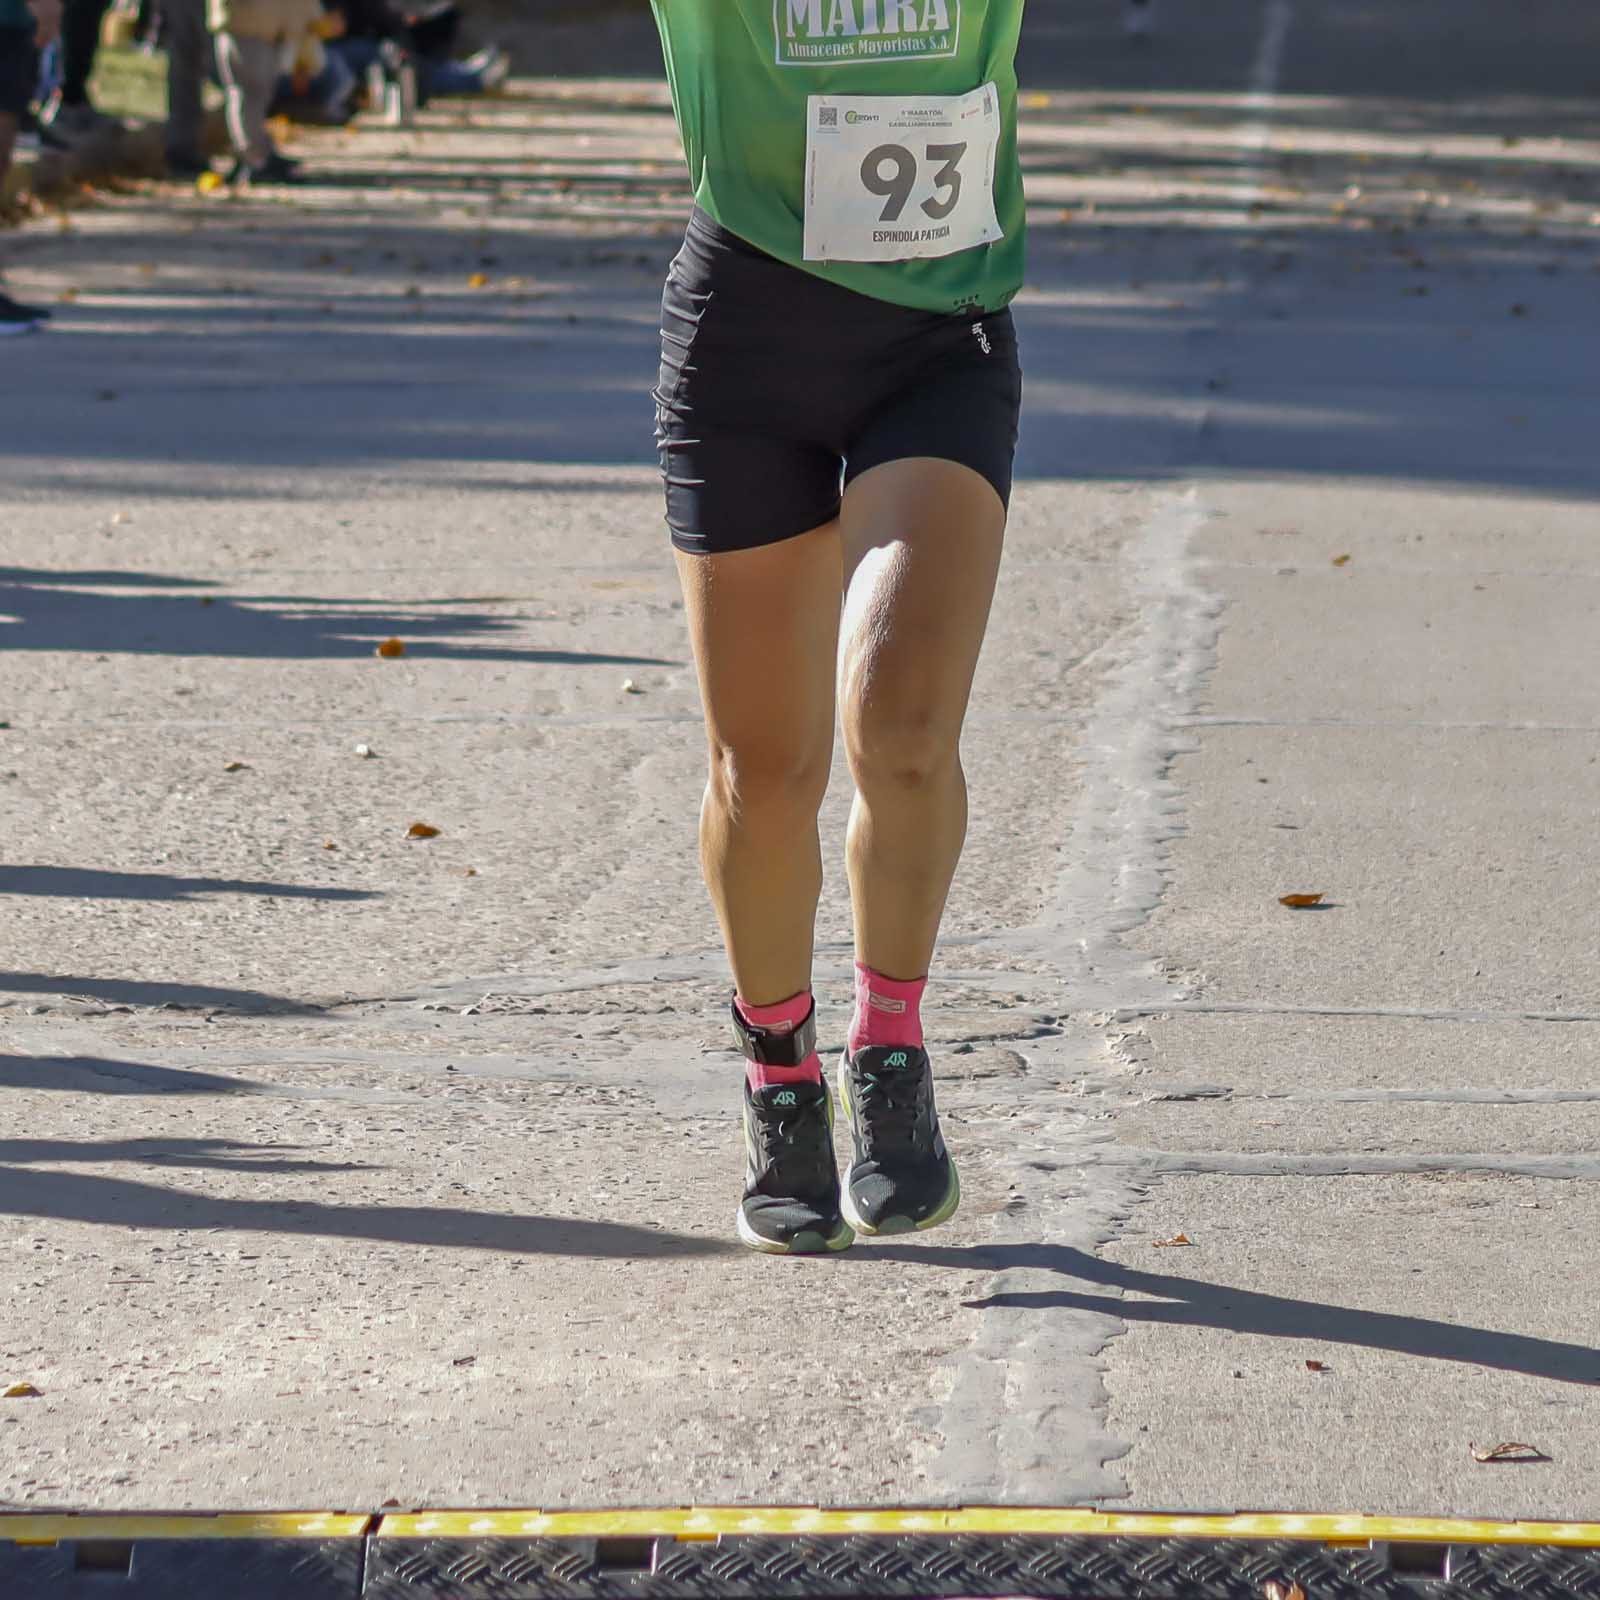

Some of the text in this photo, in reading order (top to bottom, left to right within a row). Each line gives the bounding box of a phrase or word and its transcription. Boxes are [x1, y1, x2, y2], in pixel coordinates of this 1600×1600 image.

[787, 34, 950, 57] Almacenes Mayoristas S.A.
[860, 141, 968, 222] 93
[872, 230, 920, 243] ESPINDOLA
